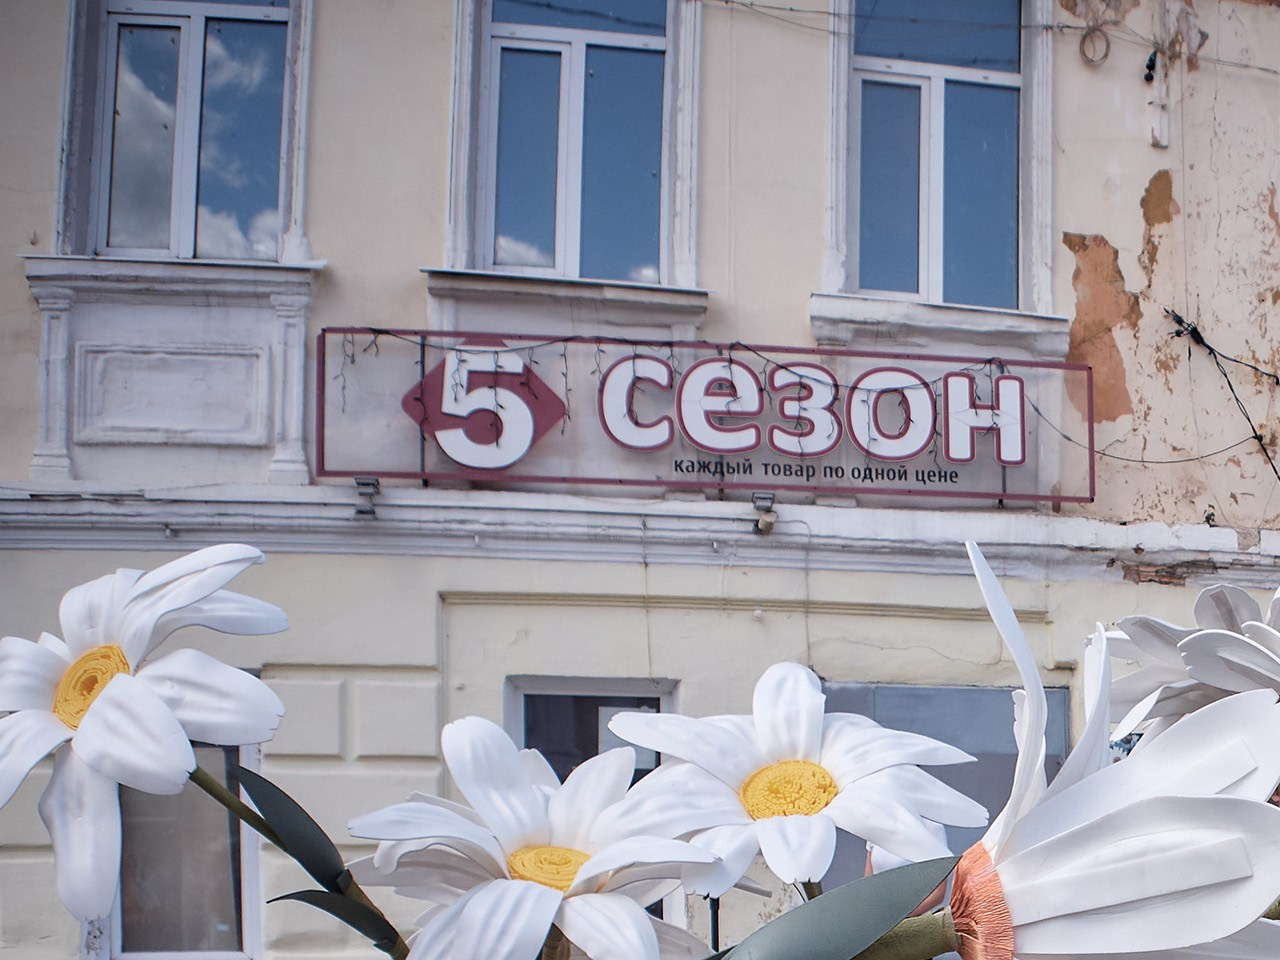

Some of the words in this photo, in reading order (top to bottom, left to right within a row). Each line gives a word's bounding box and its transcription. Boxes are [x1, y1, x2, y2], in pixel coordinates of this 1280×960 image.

[433, 346, 536, 470] 5
[597, 353, 1027, 466] сезон
[674, 458, 753, 476] каждый
[762, 463, 816, 482] товар
[823, 465, 845, 480] по
[851, 465, 908, 483] одной
[915, 470, 959, 485] цене
